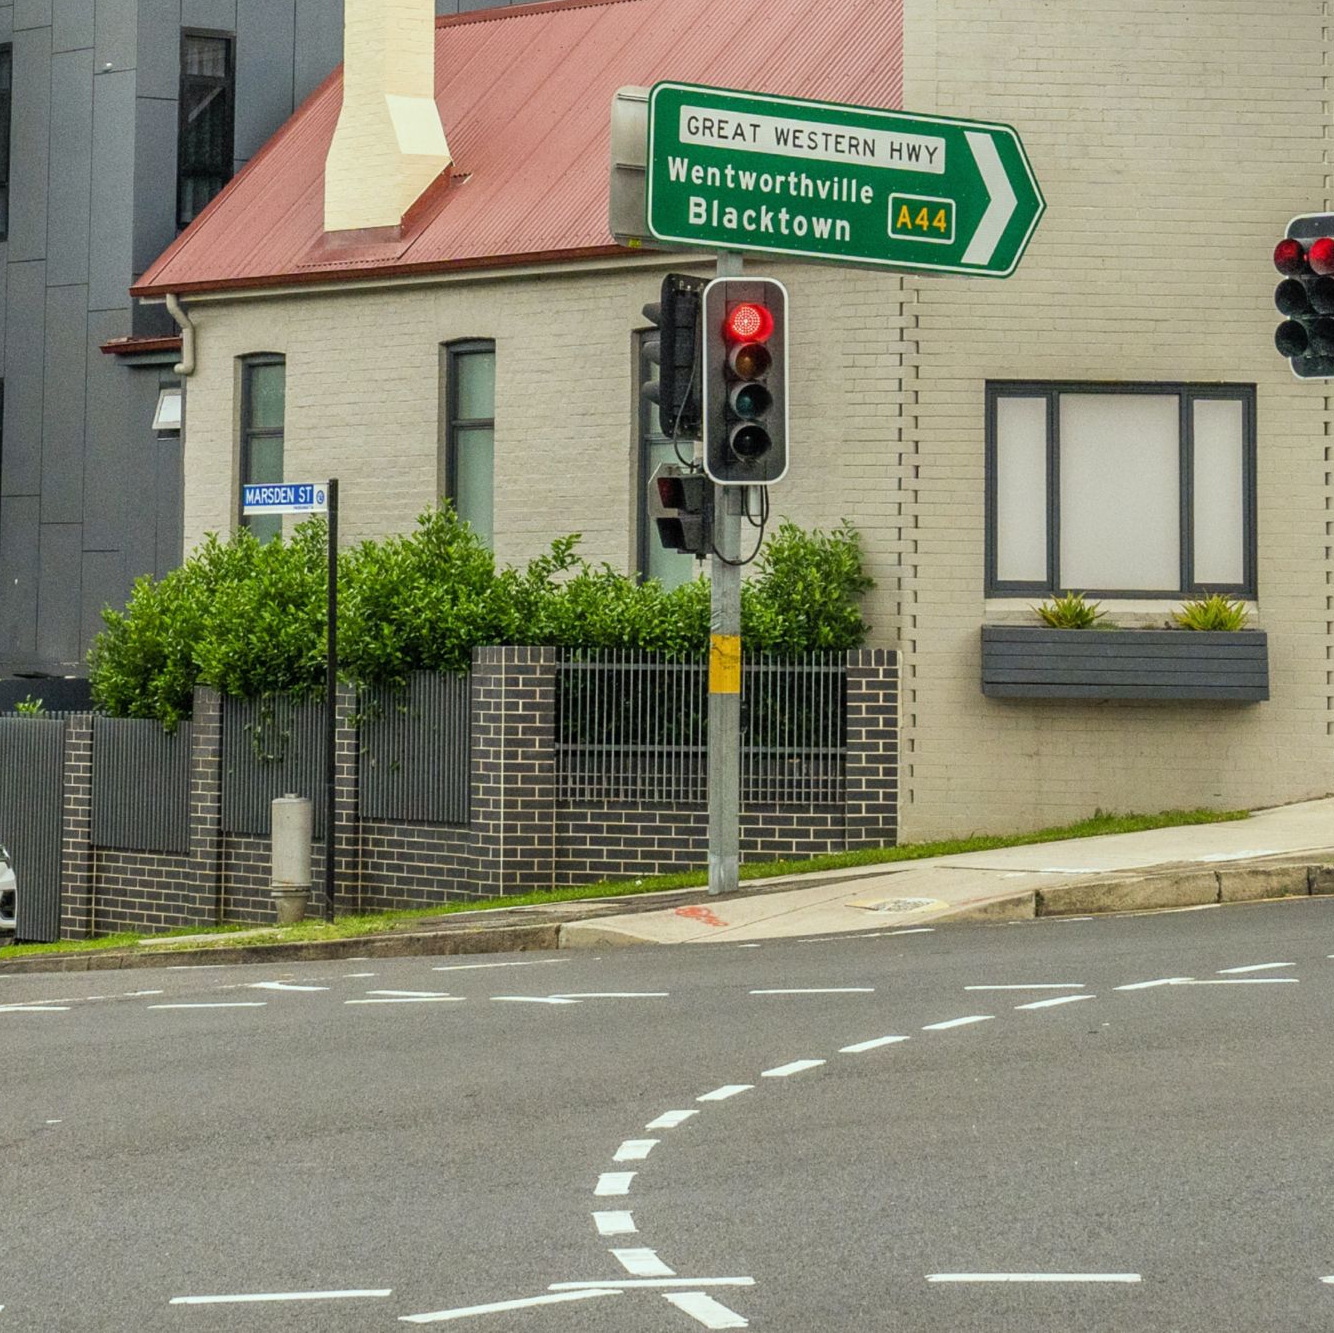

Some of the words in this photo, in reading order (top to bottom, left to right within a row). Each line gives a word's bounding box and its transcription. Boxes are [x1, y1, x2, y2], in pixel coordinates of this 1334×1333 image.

[686, 115, 761, 145] GREAT
[774, 127, 876, 158] WESTERN
[889, 140, 939, 165] HWY
[667, 156, 874, 205] Wentworthville
[688, 196, 851, 241] Blacktown
[896, 204, 947, 233] A44
[245, 487, 295, 504] MARSDEN
[298, 486, 312, 503] ST
